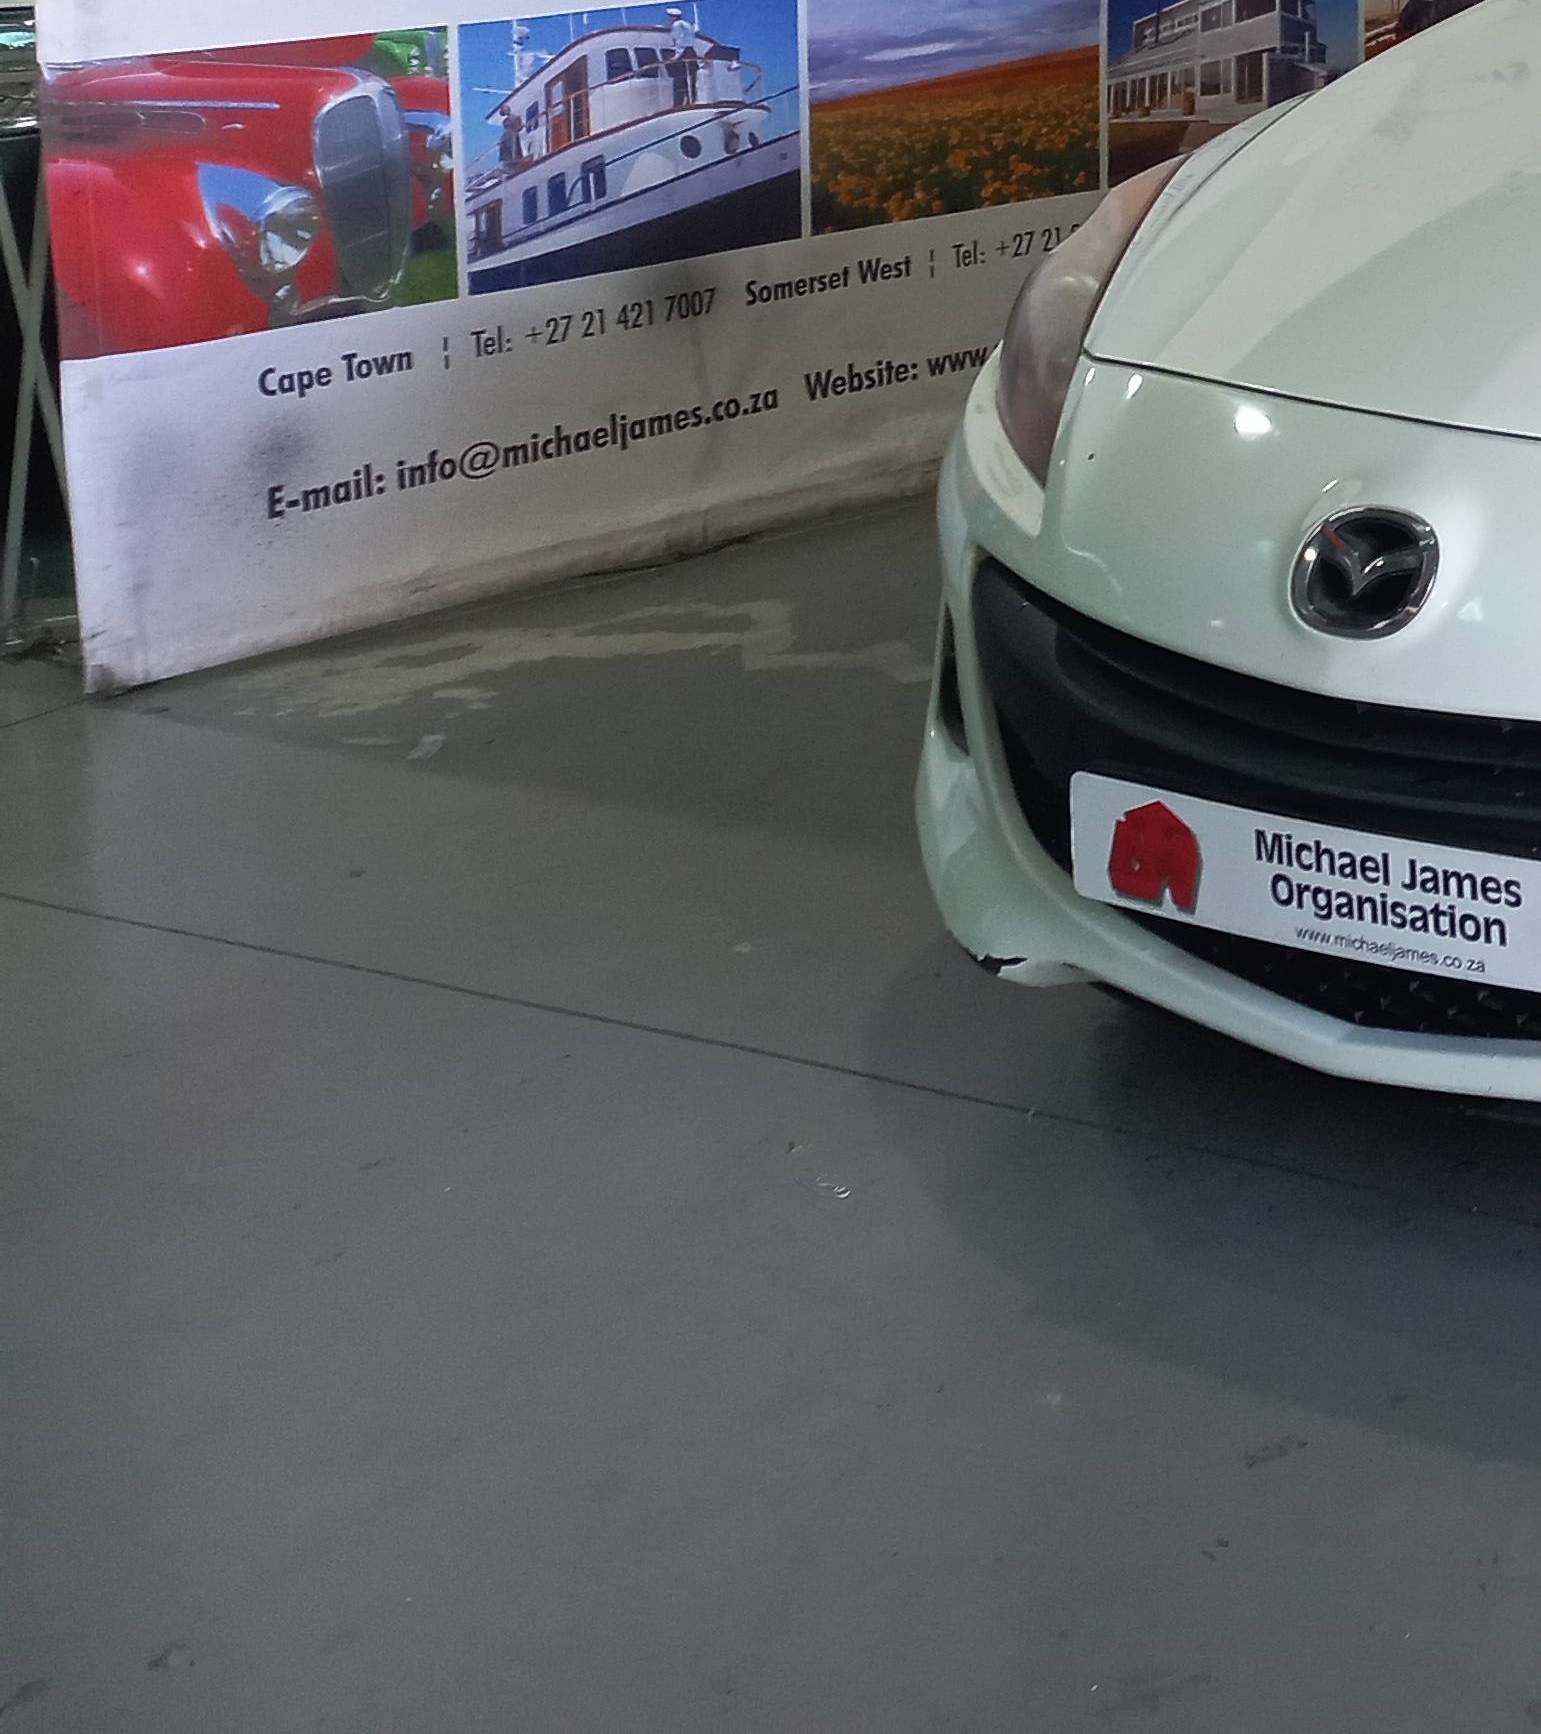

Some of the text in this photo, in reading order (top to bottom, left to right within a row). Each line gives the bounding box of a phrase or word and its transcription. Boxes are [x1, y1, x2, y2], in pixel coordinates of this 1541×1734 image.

[746, 267, 849, 306] Somerset
[858, 256, 911, 284] West
[952, 240, 985, 268] Tel:
[996, 231, 1035, 258] +27
[259, 288, 716, 398] Cape Town Tel: +27 21 421 7007
[805, 360, 918, 401] Website:
[268, 389, 778, 519] E-mail: info@michaeljames.co.za
[1255, 829, 1521, 907] Michael James
[1270, 873, 1508, 948] Organisation
